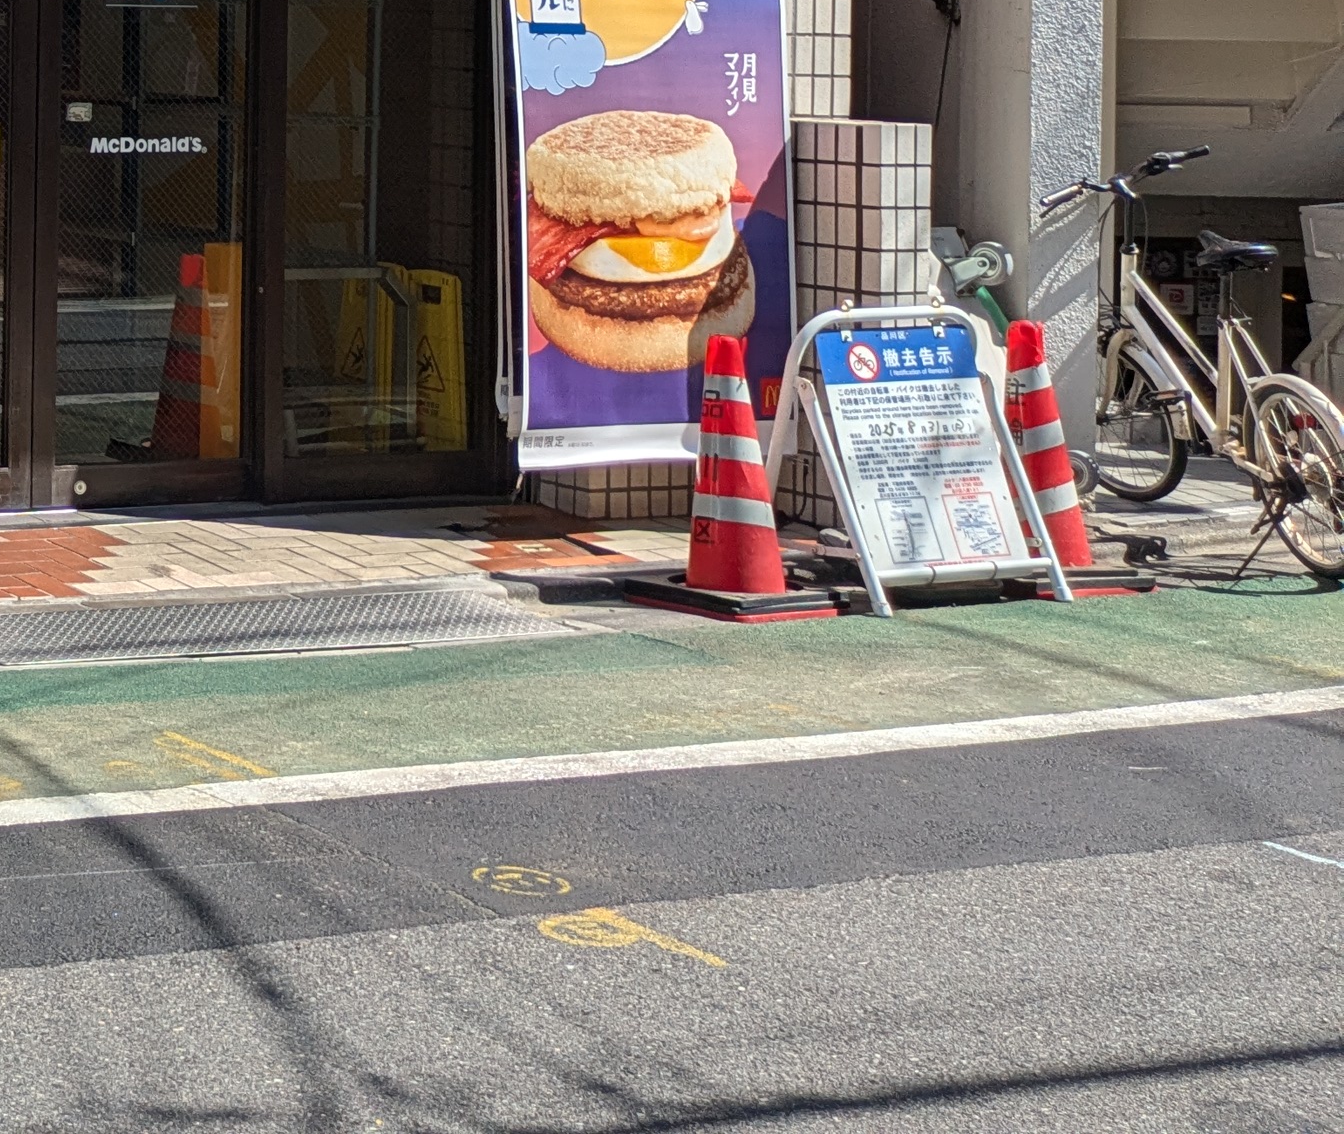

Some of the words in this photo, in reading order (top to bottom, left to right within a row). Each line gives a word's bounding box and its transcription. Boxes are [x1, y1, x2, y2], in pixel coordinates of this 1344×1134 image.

[723, 52, 740, 117] マフィン
[741, 52, 758, 103] 月見
[882, 346, 954, 368] 撤去告示
